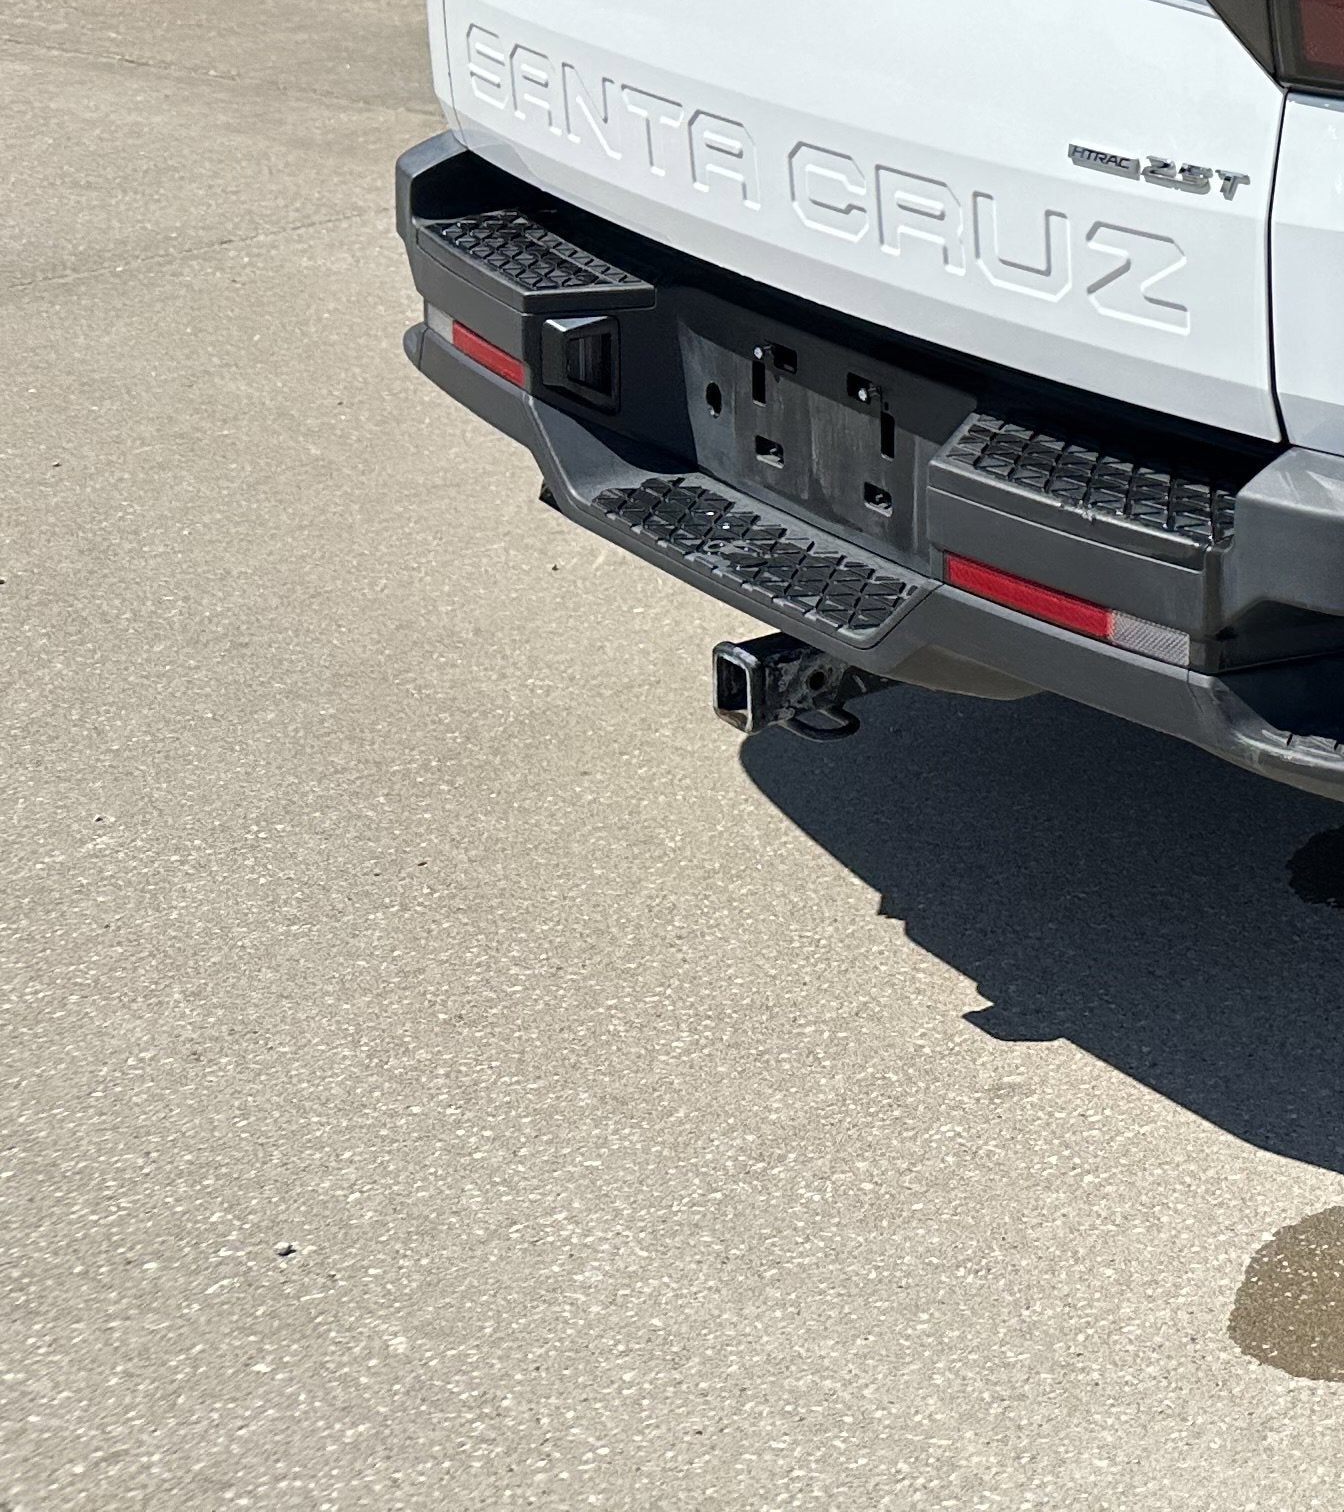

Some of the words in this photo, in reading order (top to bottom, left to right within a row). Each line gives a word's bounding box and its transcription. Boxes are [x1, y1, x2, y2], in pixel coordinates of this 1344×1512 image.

[465, 22, 762, 211] SANTA
[787, 140, 1191, 336] CRUZ
[1070, 144, 1132, 170] HTRAC
